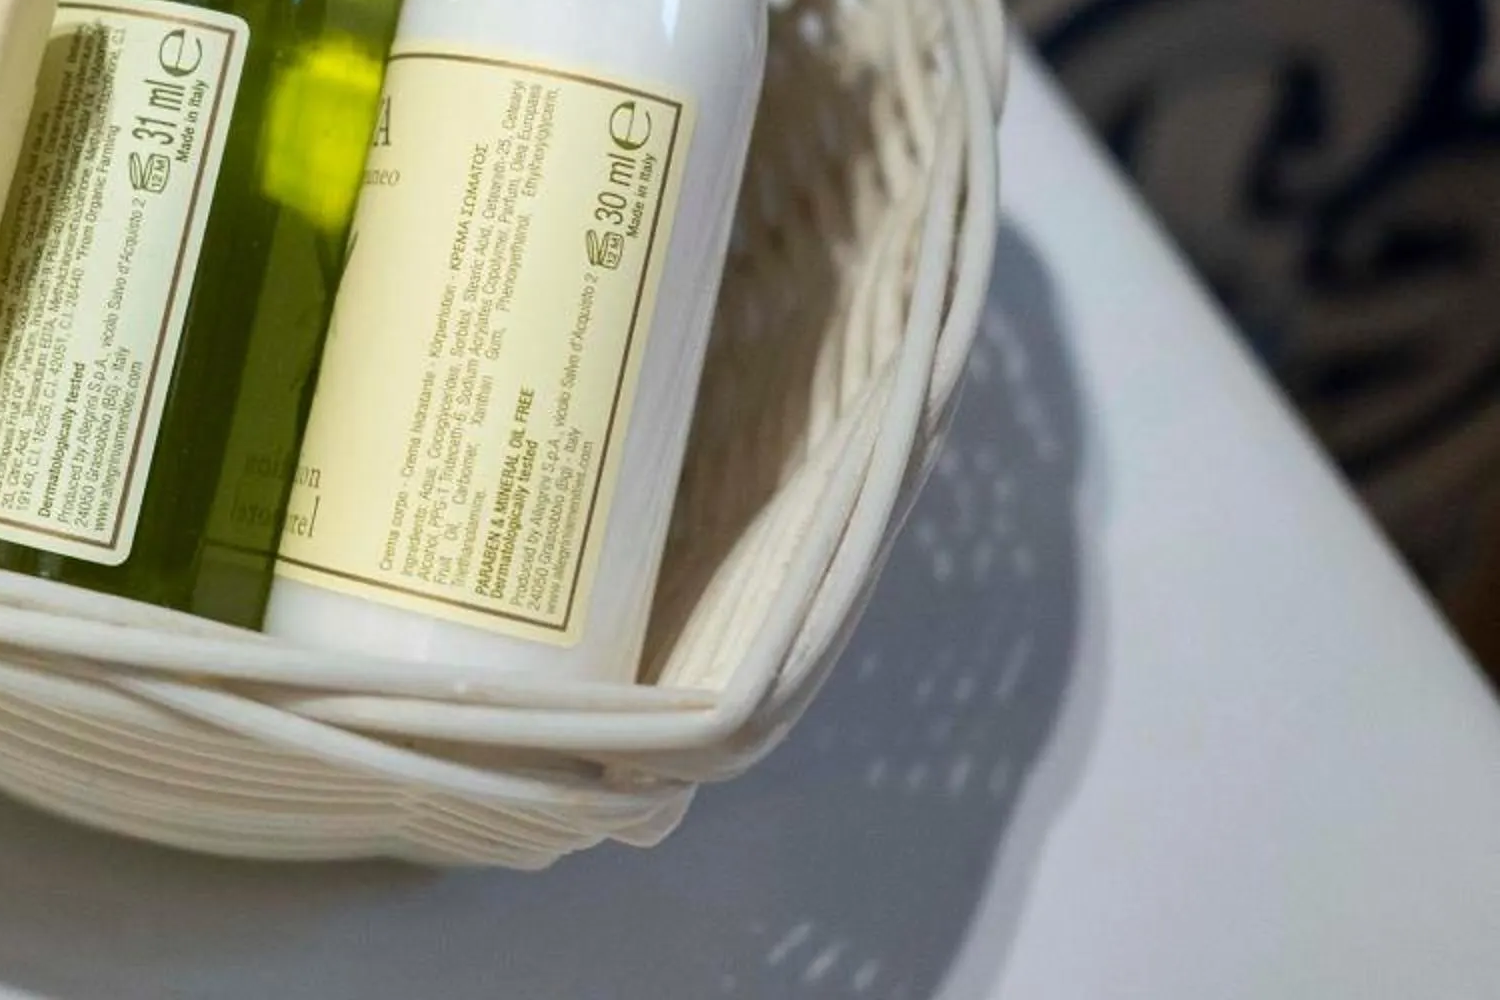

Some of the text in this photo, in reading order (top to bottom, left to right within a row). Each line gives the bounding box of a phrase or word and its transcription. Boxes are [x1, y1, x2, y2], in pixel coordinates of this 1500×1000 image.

[144, 77, 186, 112] ml
[133, 116, 177, 146] 31
[175, 78, 208, 161] Made in Italy
[605, 155, 637, 187] ml
[595, 191, 627, 226] 30
[624, 152, 655, 238] Made in Italy
[584, 272, 598, 282] 2
[55, 463, 82, 523] Produced
[70, 445, 89, 463] by
[130, 196, 146, 208] 2
[514, 386, 534, 422] FREE
[37, 361, 85, 518] Dermatologically tested
[508, 425, 525, 449] OIL
[493, 452, 519, 513] MINERAL
[73, 484, 96, 527] 24050
[490, 439, 538, 599] Dermatologically tested
[474, 530, 501, 595] PARABEN
